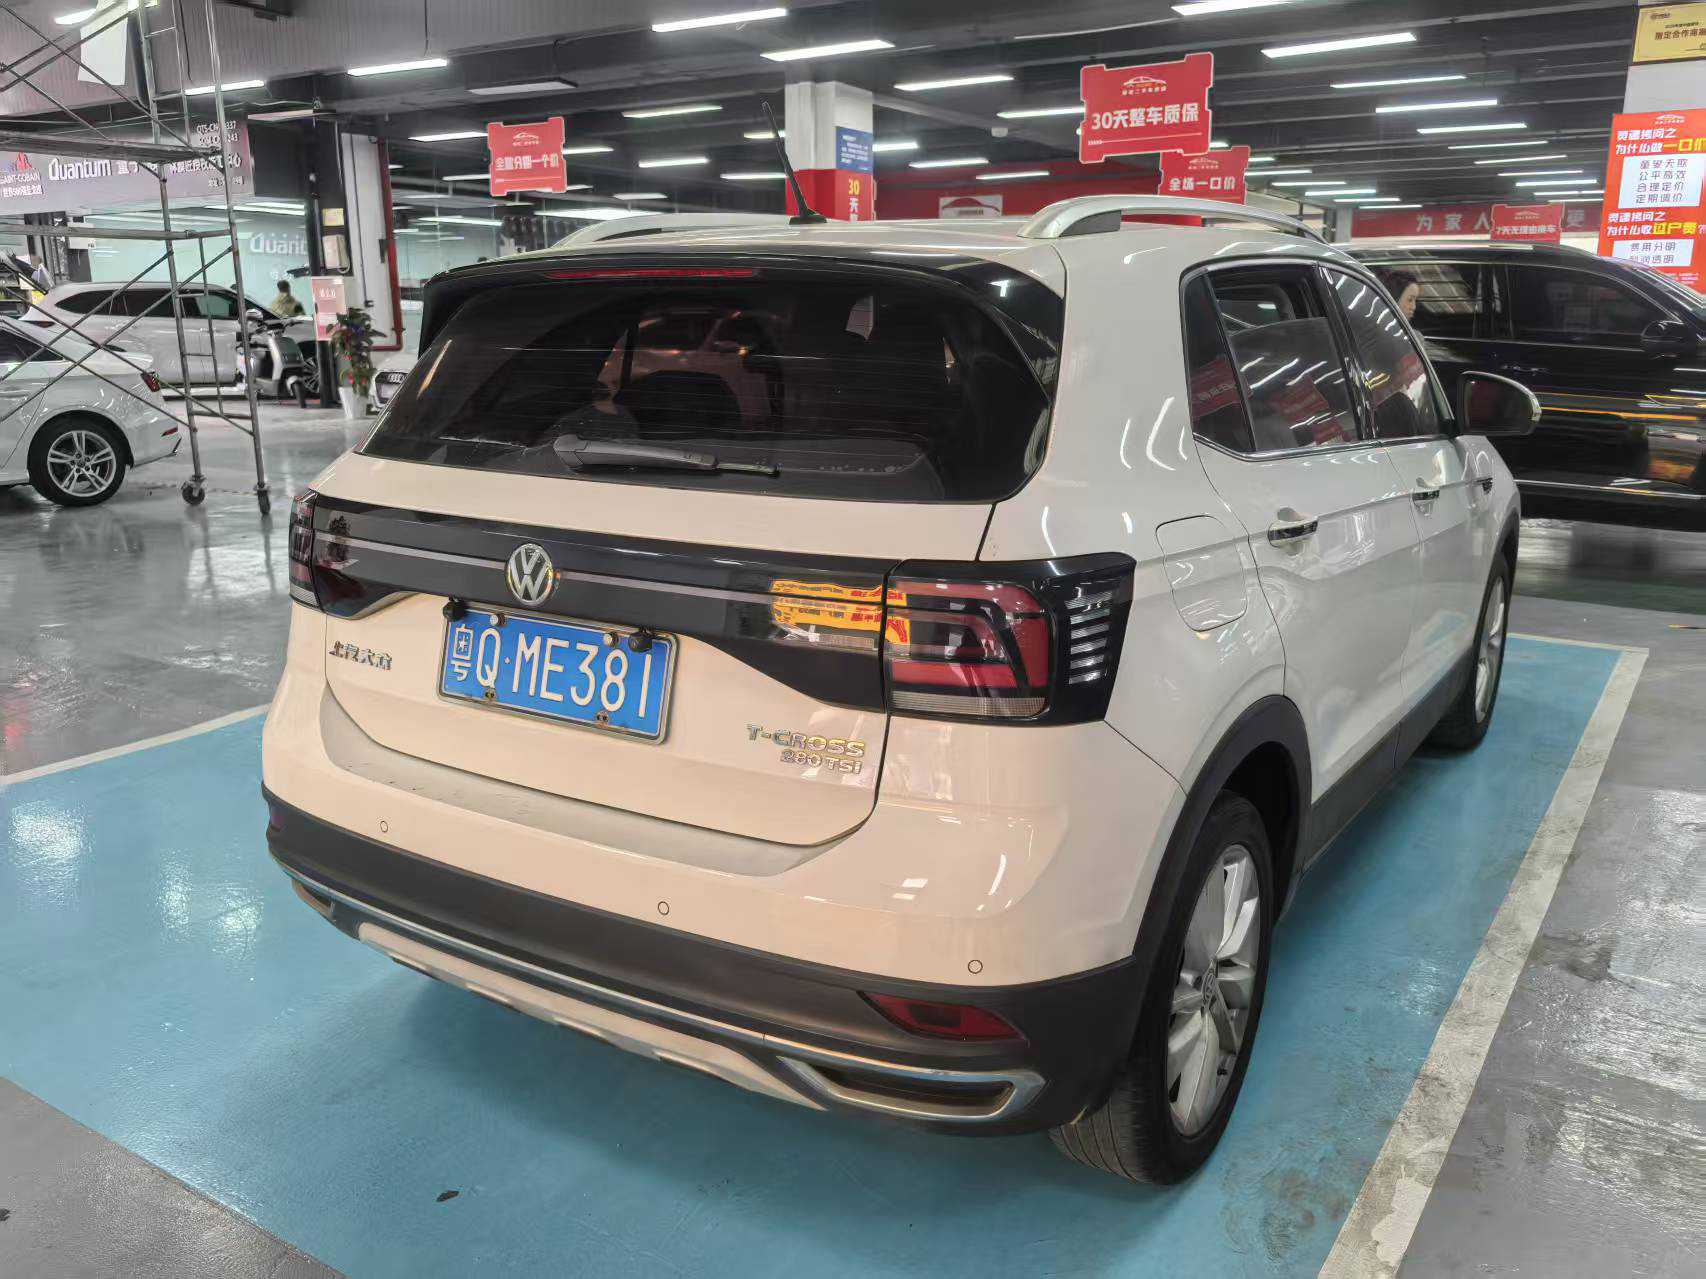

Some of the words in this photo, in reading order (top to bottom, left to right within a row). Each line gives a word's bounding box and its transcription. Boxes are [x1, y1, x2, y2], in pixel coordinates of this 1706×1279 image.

[1091, 103, 1199, 130] 30天整车质保
[48, 157, 112, 181] Quantum
[1640, 170, 1686, 181] 公平高效
[1637, 182, 1684, 193] 合理定价
[1636, 193, 1683, 204] 定期调价
[1631, 242, 1676, 252] 费用分明
[746, 724, 866, 758] T-CROSS
